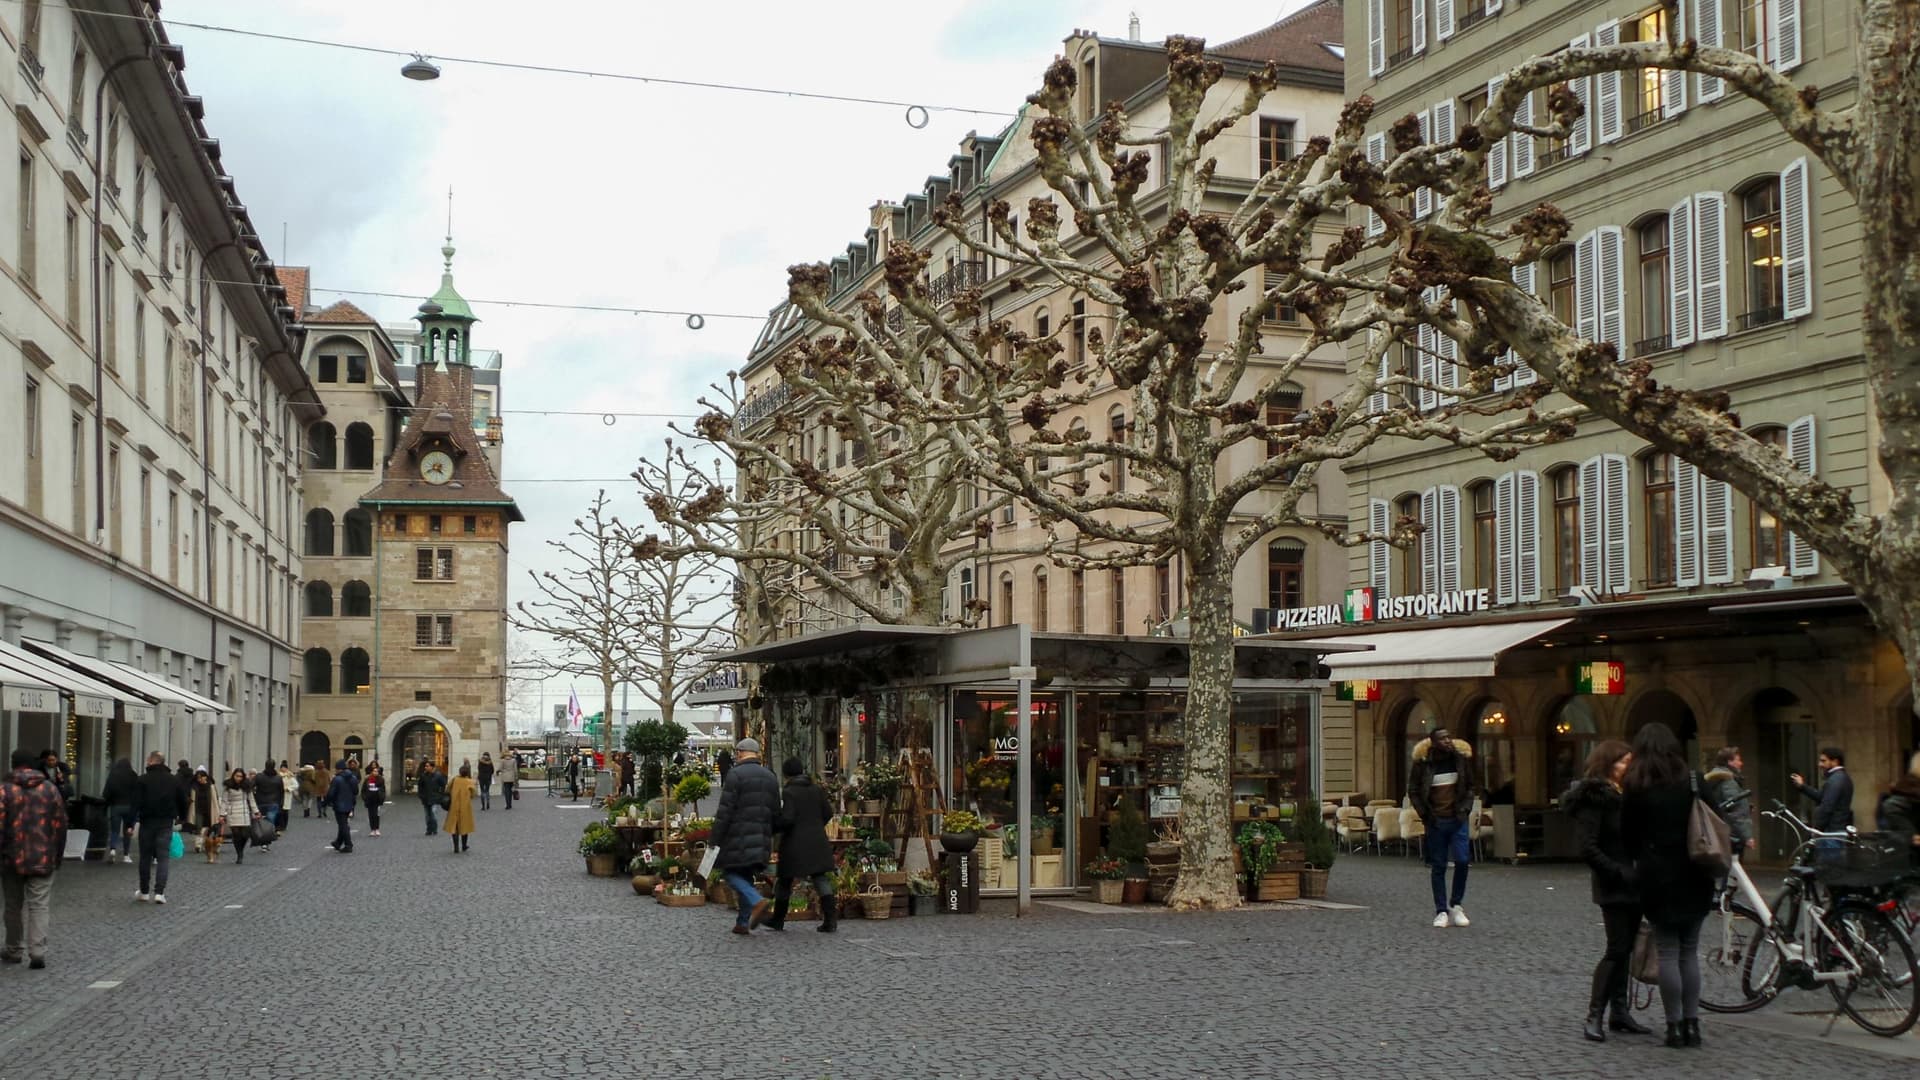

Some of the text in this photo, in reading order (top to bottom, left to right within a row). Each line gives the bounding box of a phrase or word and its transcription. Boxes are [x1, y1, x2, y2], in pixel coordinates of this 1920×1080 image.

[1377, 588, 1489, 620] RISTORANTE
[1277, 604, 1341, 629] PIZZERIA
[994, 736, 1019, 750] MO
[950, 889, 958, 911] MOG
